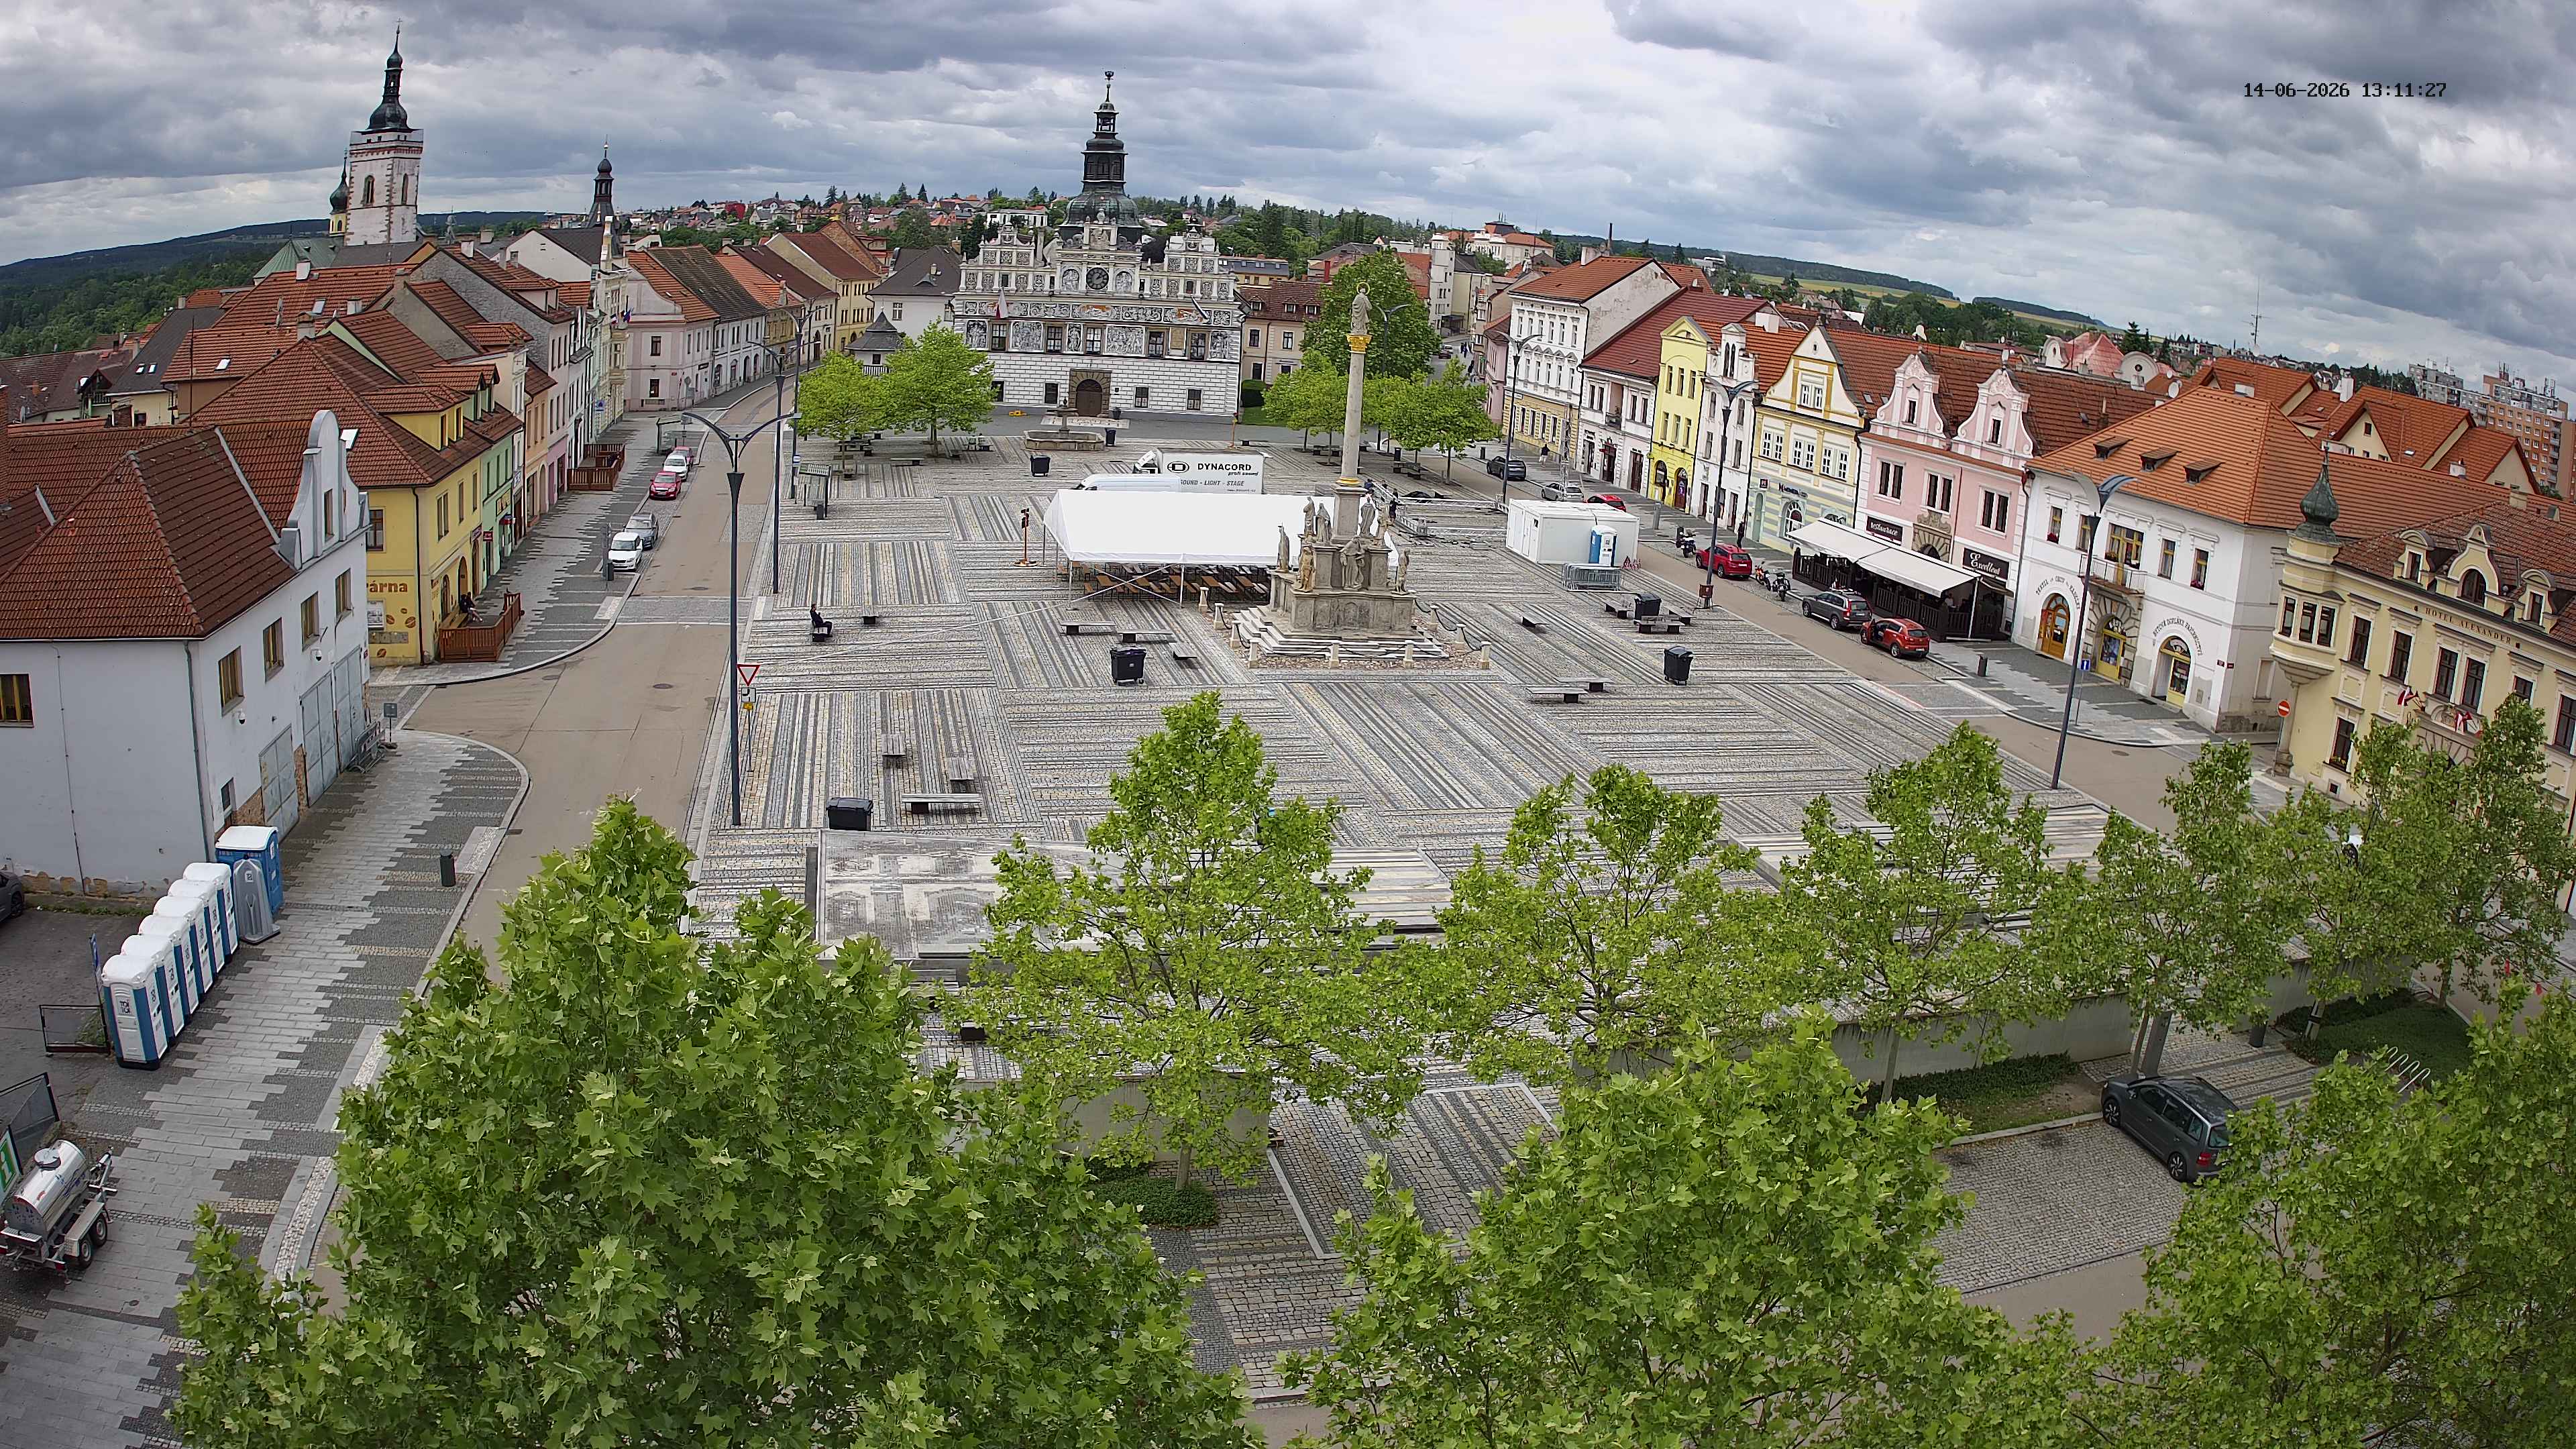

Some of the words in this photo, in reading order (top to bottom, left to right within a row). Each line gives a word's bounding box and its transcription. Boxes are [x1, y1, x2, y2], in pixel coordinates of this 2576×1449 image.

[1197, 463, 1252, 471] DYNACORD
[1970, 552, 2001, 575] Excellent
[366, 580, 408, 592] árna
[2426, 607, 2454, 625] HOTEL
[2459, 620, 2512, 645] ALEXANDER
